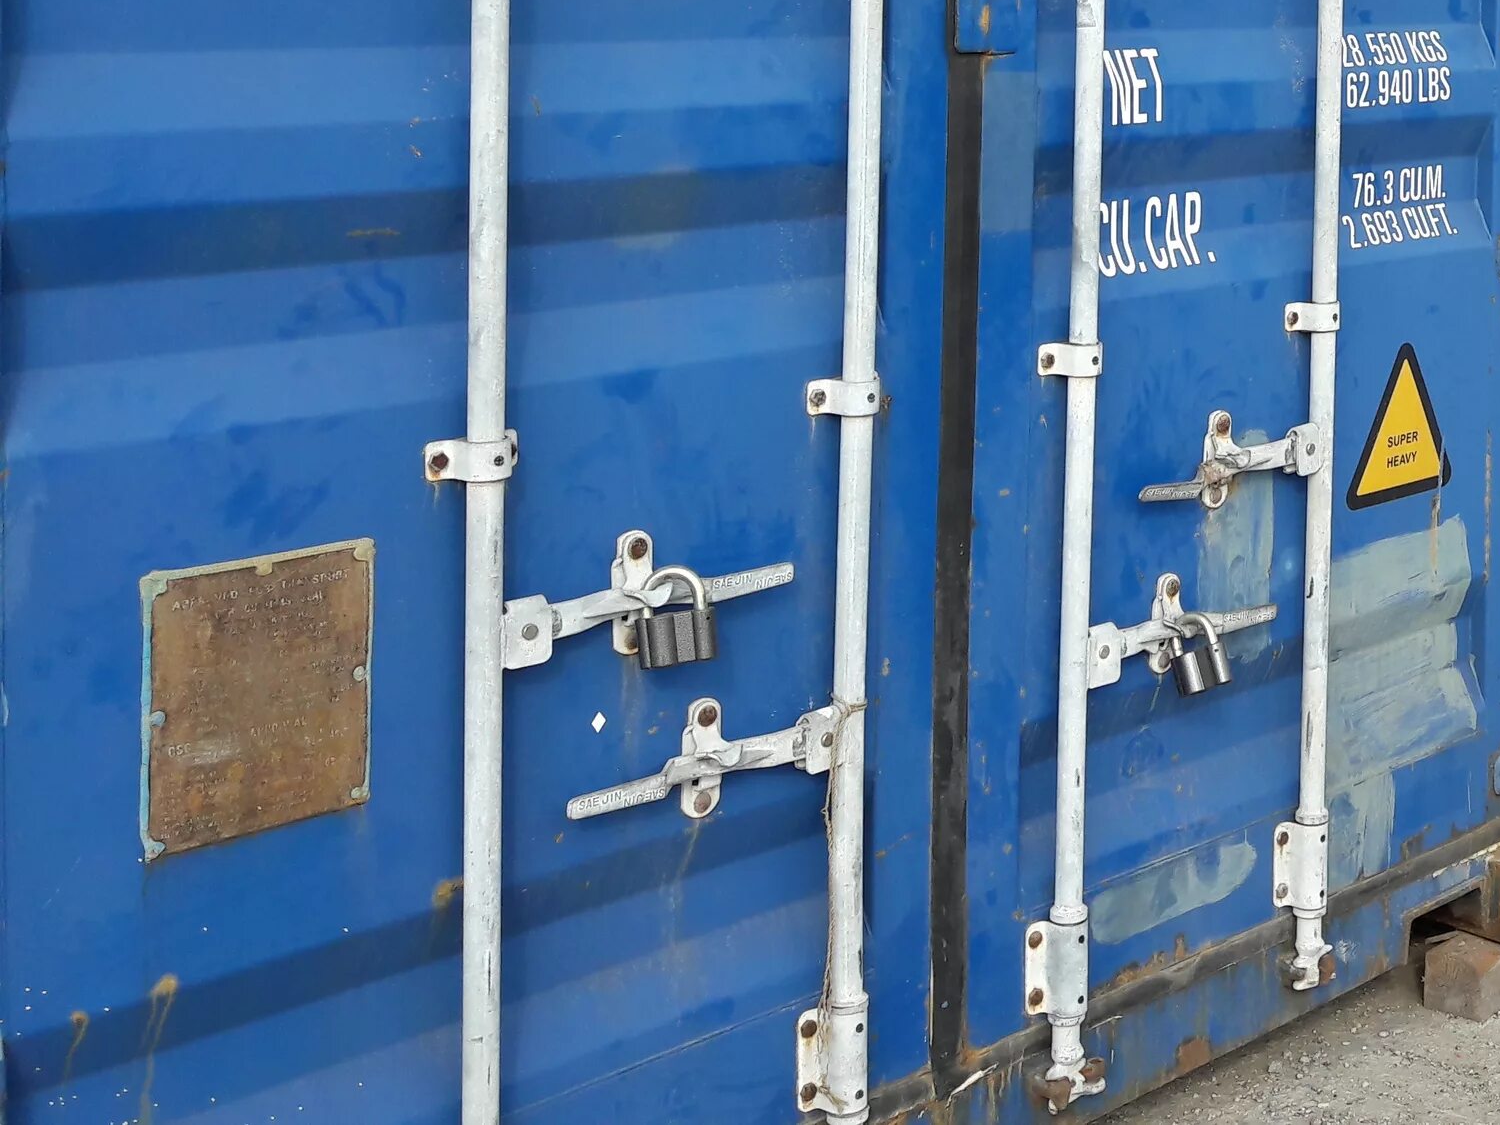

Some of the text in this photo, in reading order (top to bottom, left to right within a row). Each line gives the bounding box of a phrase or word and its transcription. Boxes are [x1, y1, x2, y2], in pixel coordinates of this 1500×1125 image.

[1102, 47, 1164, 126] NET
[1405, 31, 1448, 63] KGS
[1418, 66, 1451, 103] LBS
[1352, 170, 1394, 208] 76.3
[1387, 430, 1419, 448] SUPER
[1386, 451, 1418, 468] HEAVY
